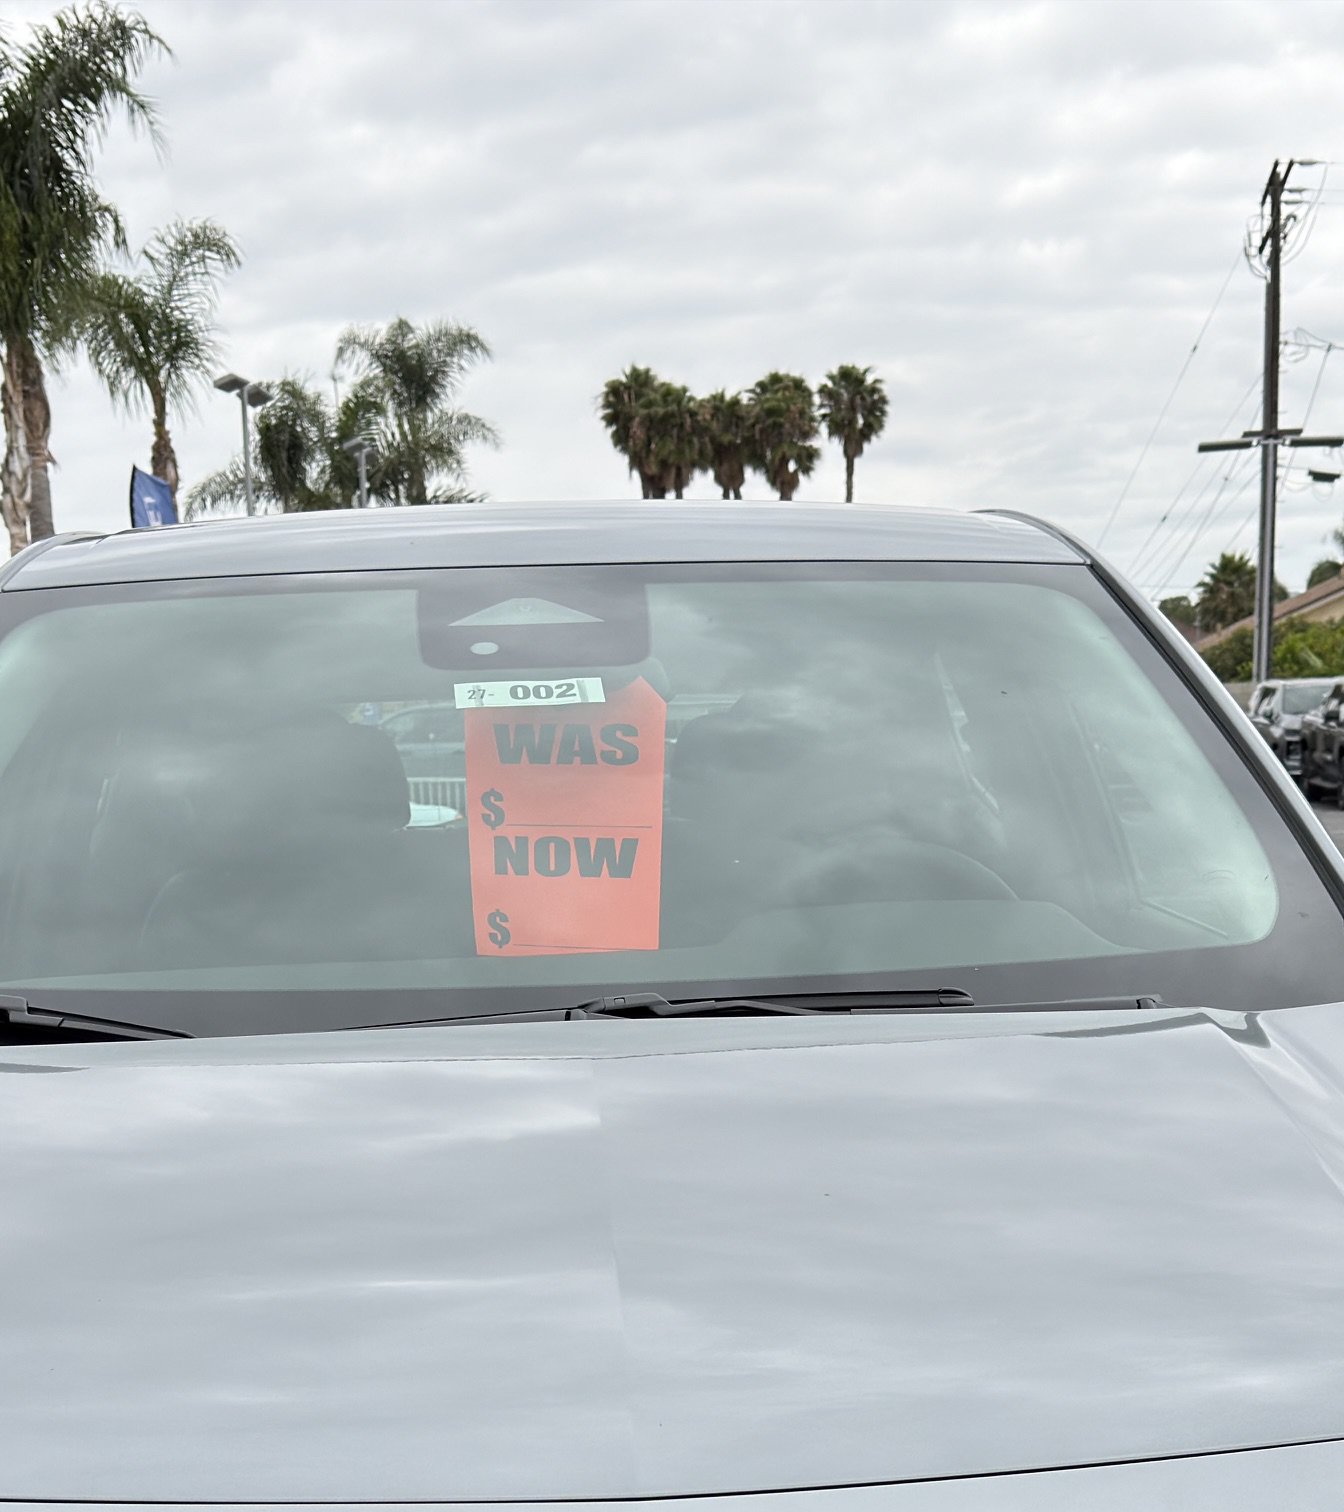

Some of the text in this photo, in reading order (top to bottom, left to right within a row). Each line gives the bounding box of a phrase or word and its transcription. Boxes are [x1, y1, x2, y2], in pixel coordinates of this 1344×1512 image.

[509, 682, 577, 700] 002
[494, 723, 640, 767] WAS
[481, 788, 506, 830] $
[494, 836, 639, 879] NOW
[487, 909, 512, 948] $
